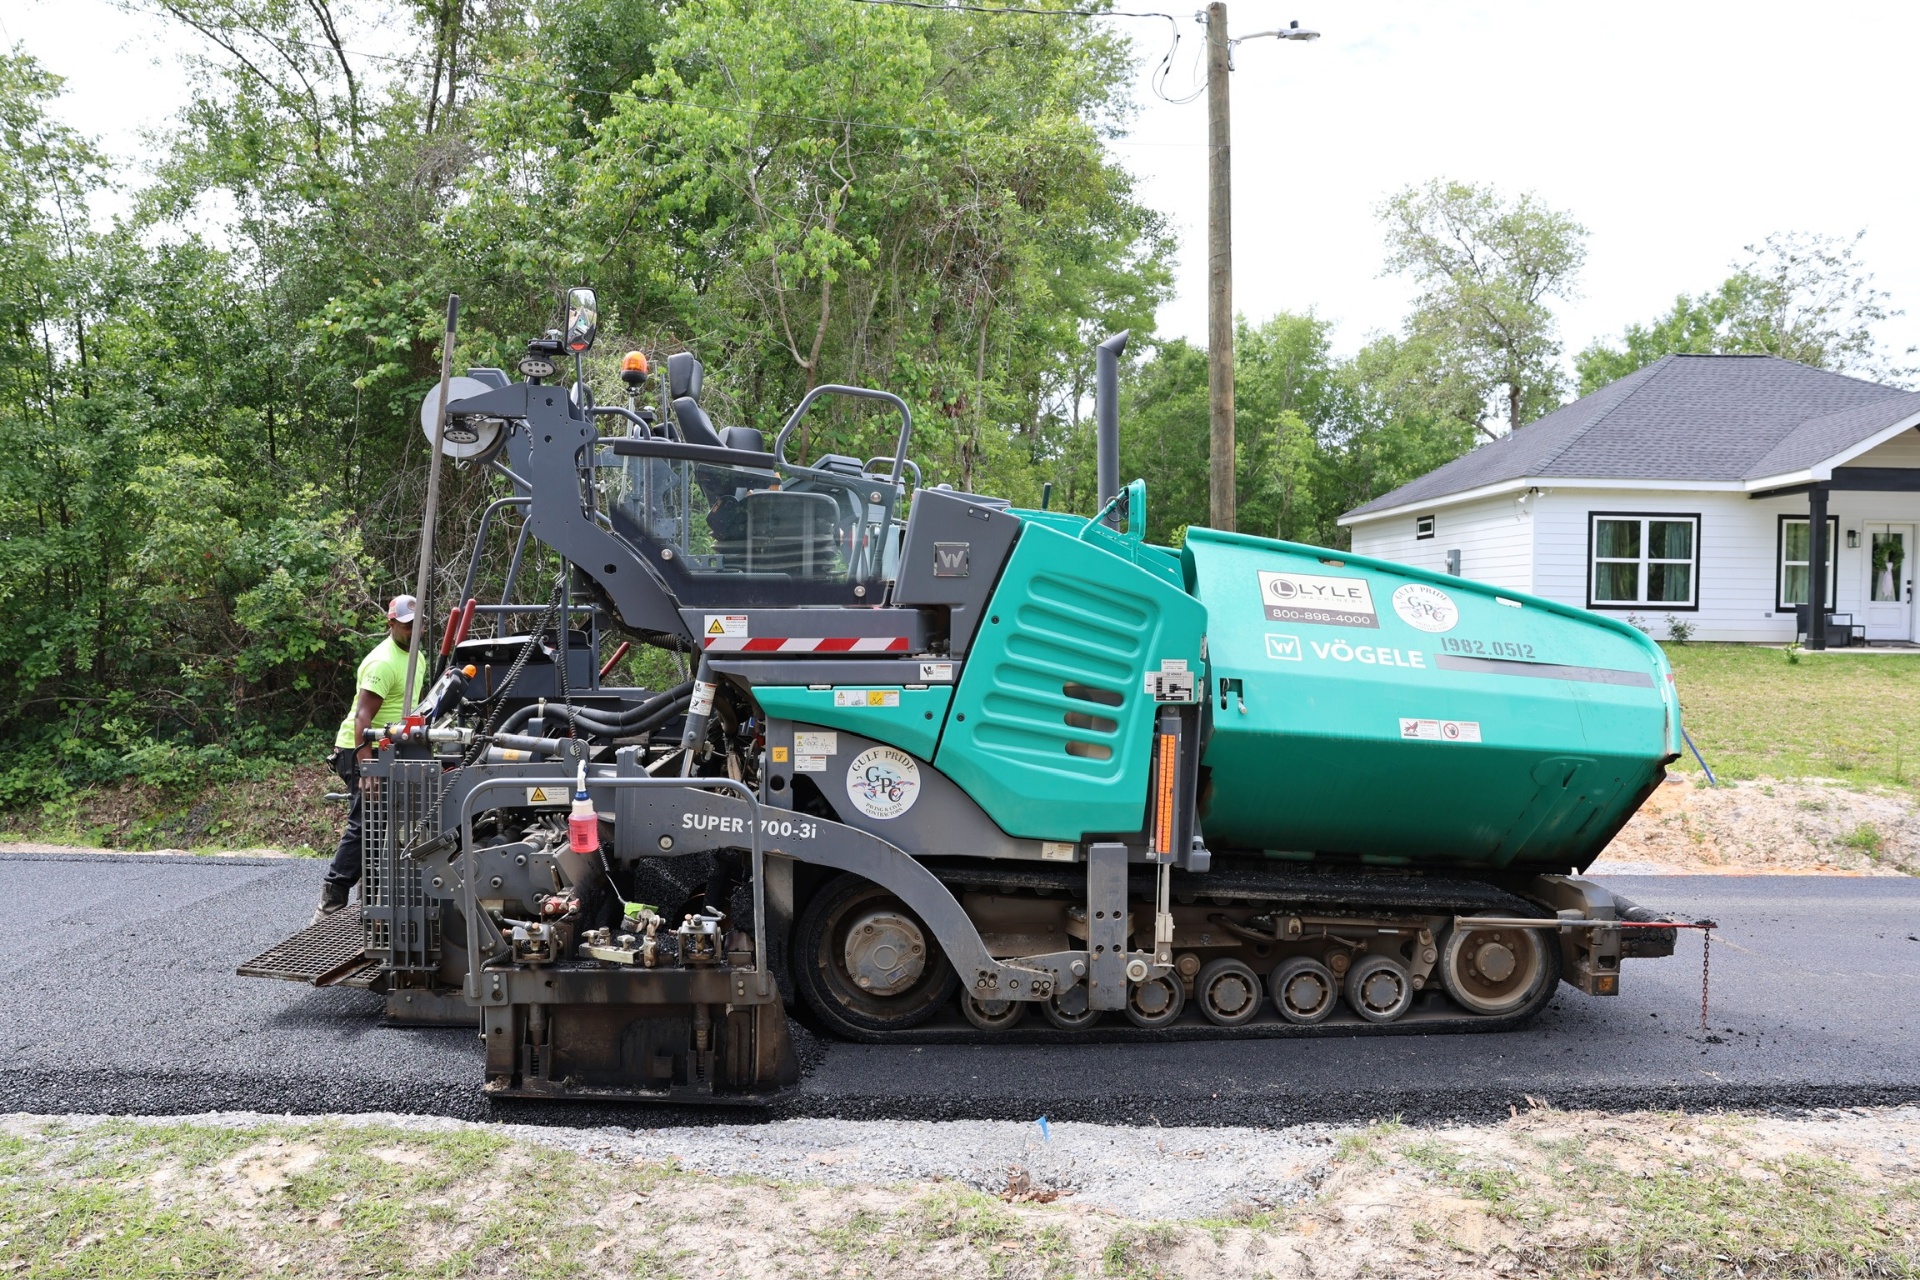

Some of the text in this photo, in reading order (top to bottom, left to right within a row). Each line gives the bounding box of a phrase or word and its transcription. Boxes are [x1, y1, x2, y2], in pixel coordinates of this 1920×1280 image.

[1298, 583, 1363, 599] LYLE
[1272, 608, 1371, 625] 800-898-4000
[1309, 638, 1427, 669] VÖGELE
[1440, 636, 1536, 659] 1982.0512
[851, 750, 880, 772] GULF
[884, 750, 917, 774] PRIDE
[682, 813, 743, 833] SUPER
